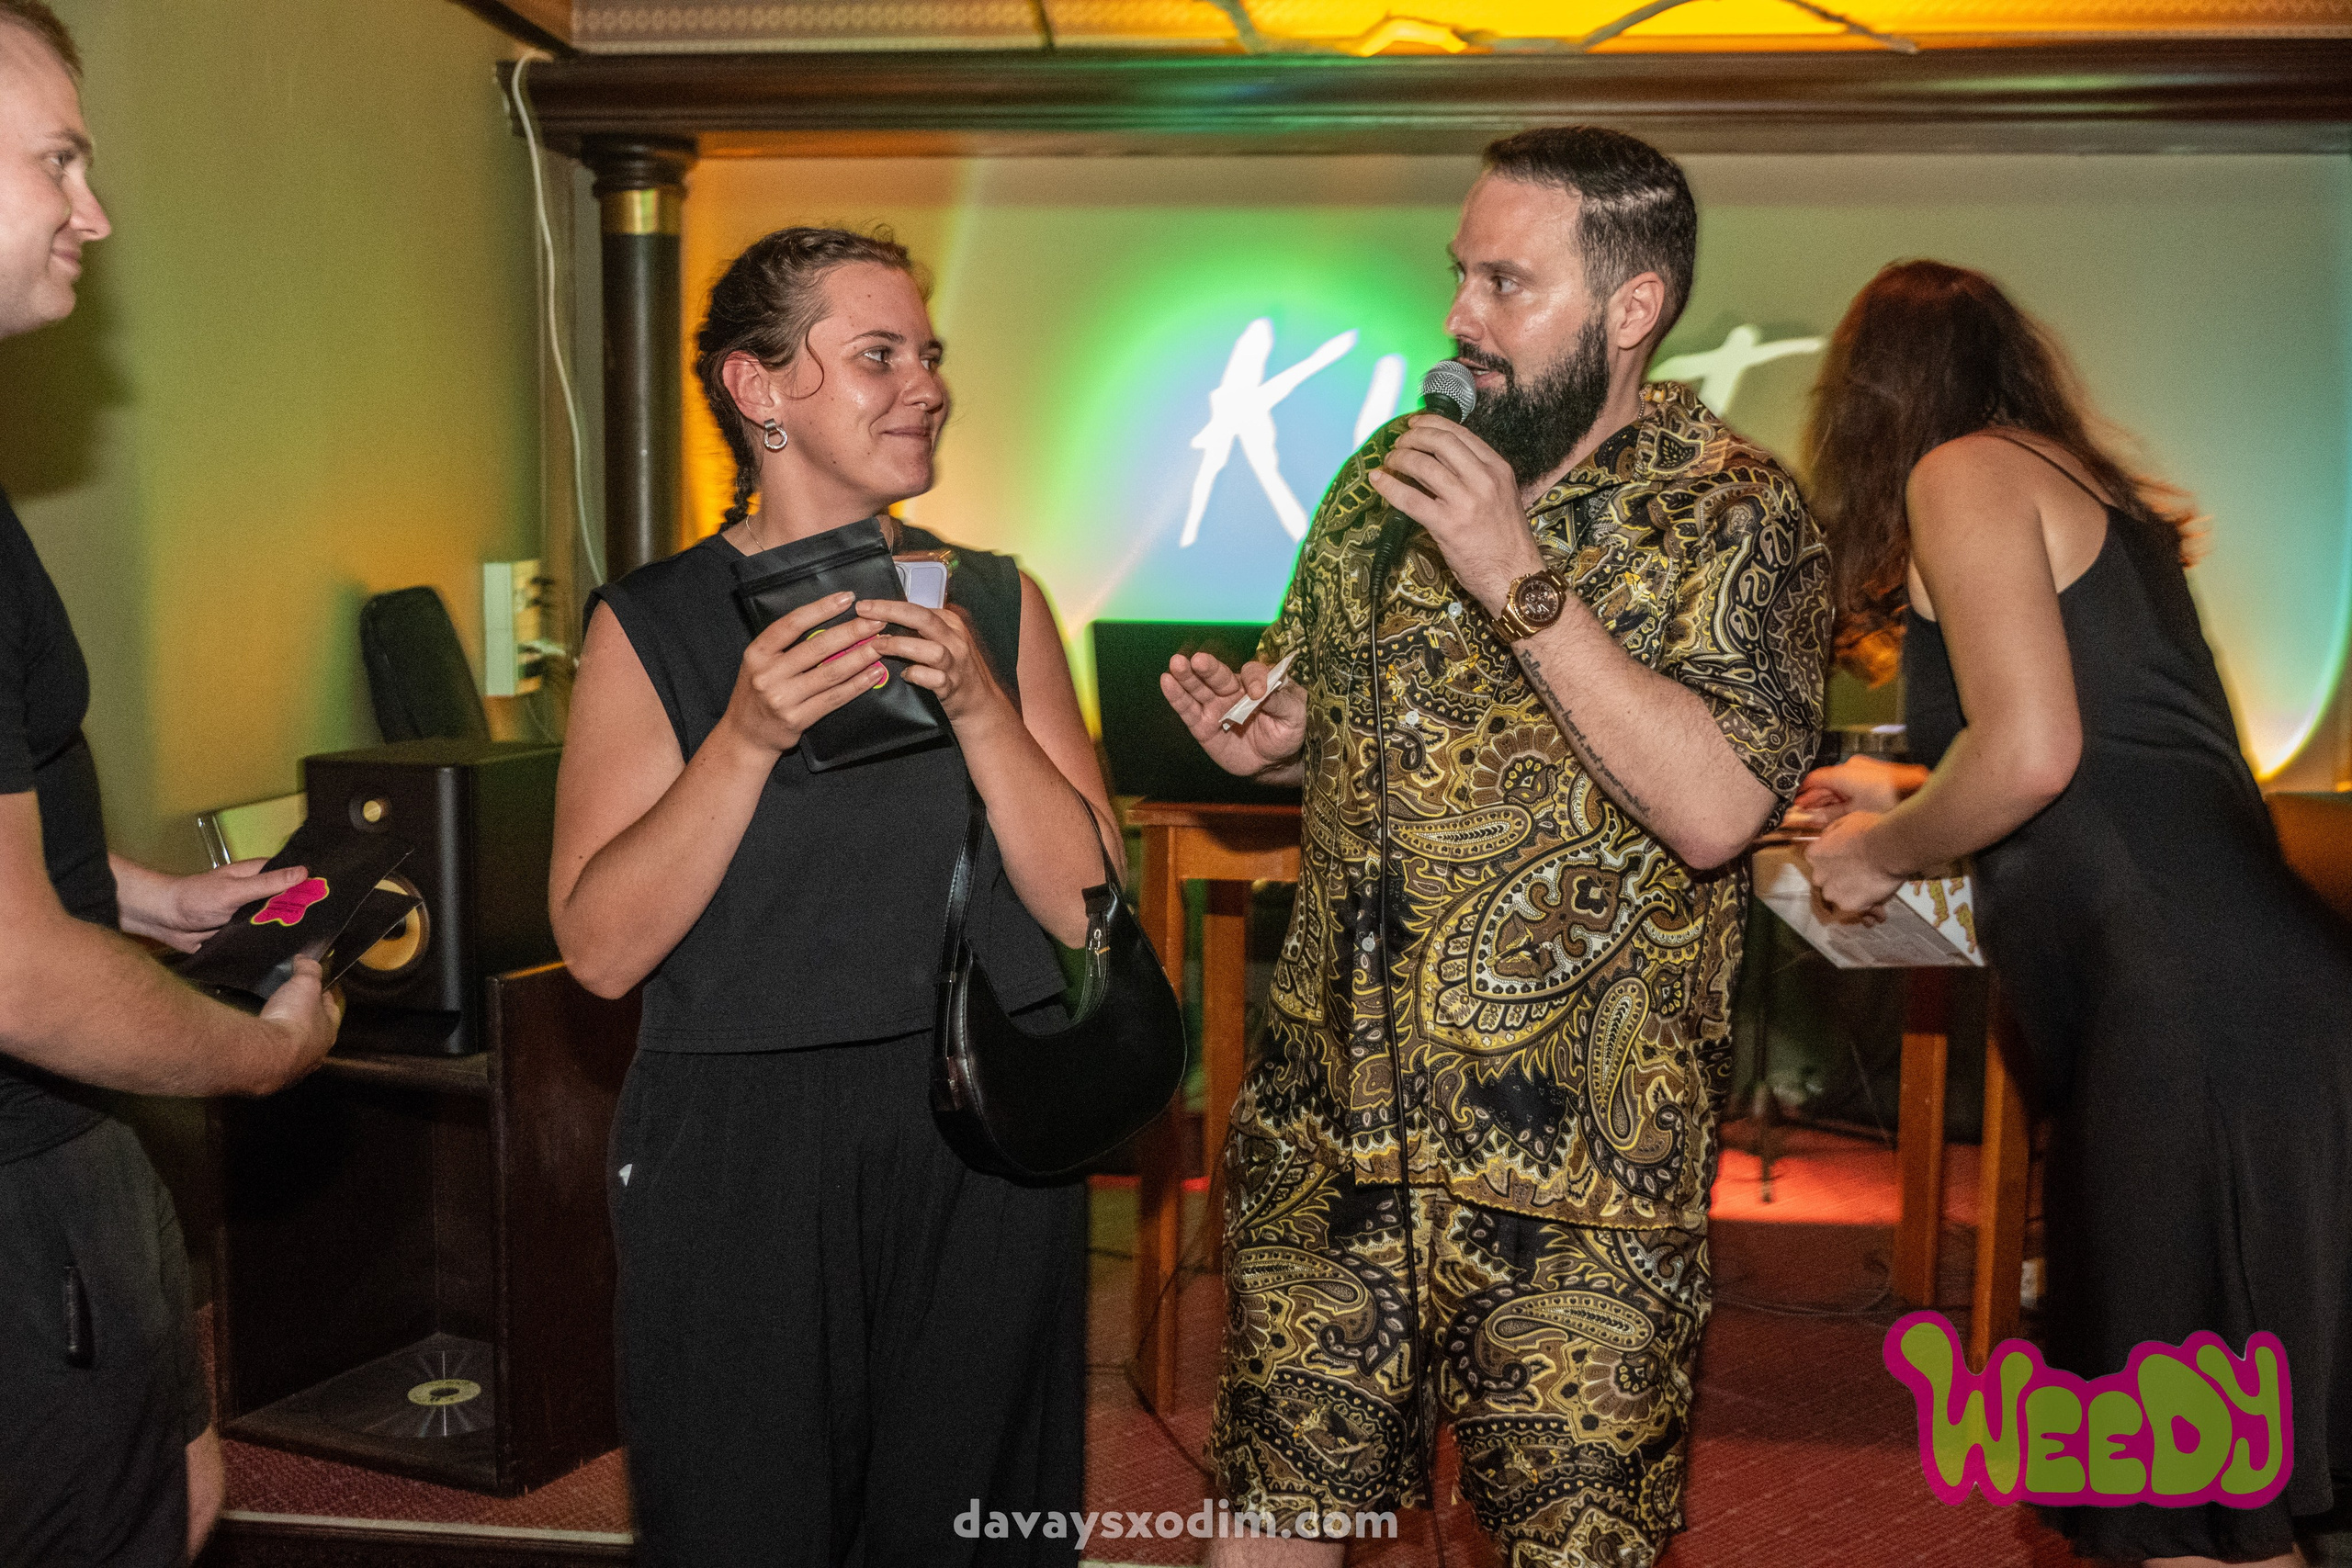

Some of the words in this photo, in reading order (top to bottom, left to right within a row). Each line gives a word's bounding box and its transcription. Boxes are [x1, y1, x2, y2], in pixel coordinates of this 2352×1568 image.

[1520, 649, 1548, 686] Follow
[1541, 684, 1565, 712] your
[1584, 744, 1602, 763] not
[1596, 762, 1623, 789] your
